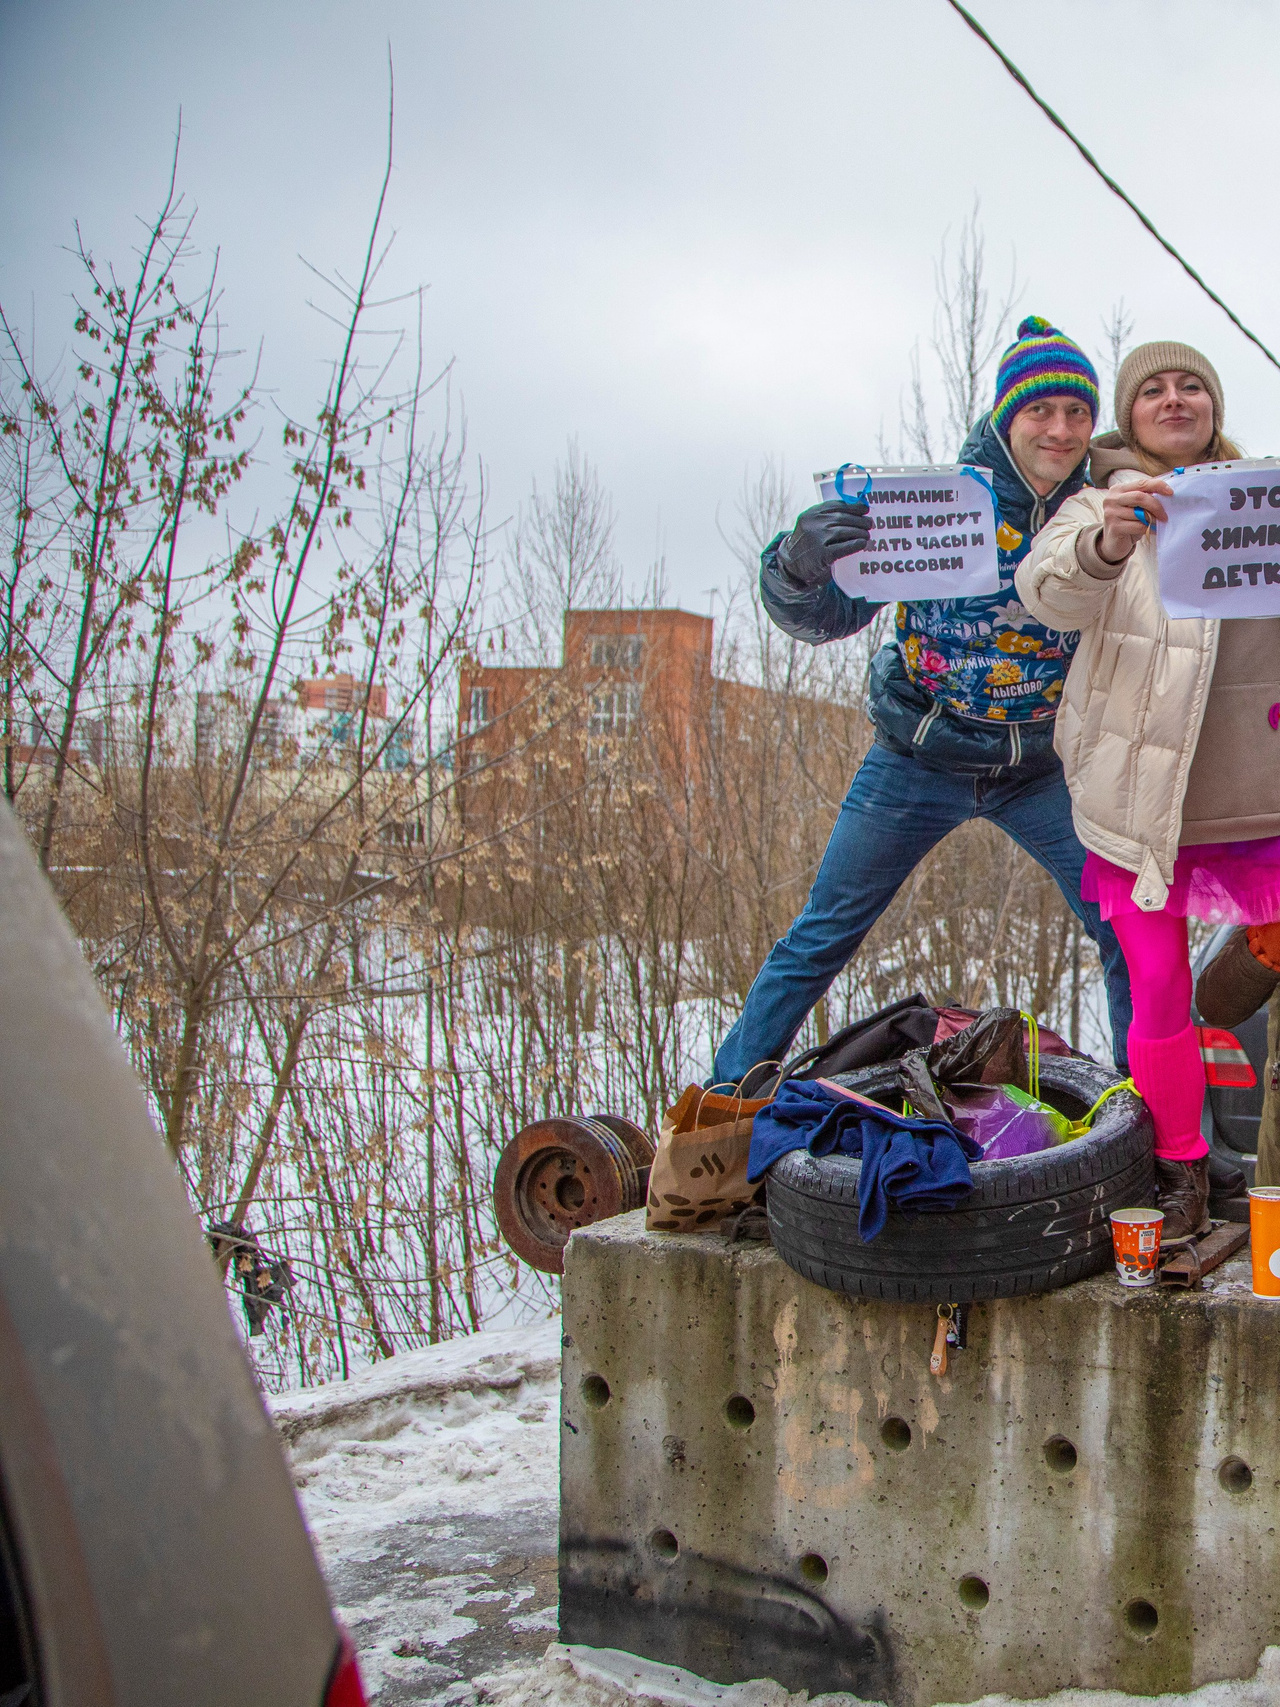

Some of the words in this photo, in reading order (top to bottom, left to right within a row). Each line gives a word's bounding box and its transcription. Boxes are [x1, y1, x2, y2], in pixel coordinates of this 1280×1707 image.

[868, 515, 913, 531] ЬШЕ
[917, 511, 982, 529] МОГУТ
[864, 537, 913, 553] ЖАТЬ
[916, 533, 968, 550] ЧАСЫ
[972, 532, 985, 546] И
[859, 556, 964, 575] КРОССОВКИ
[992, 680, 1043, 699] ЛЫСКОВО
